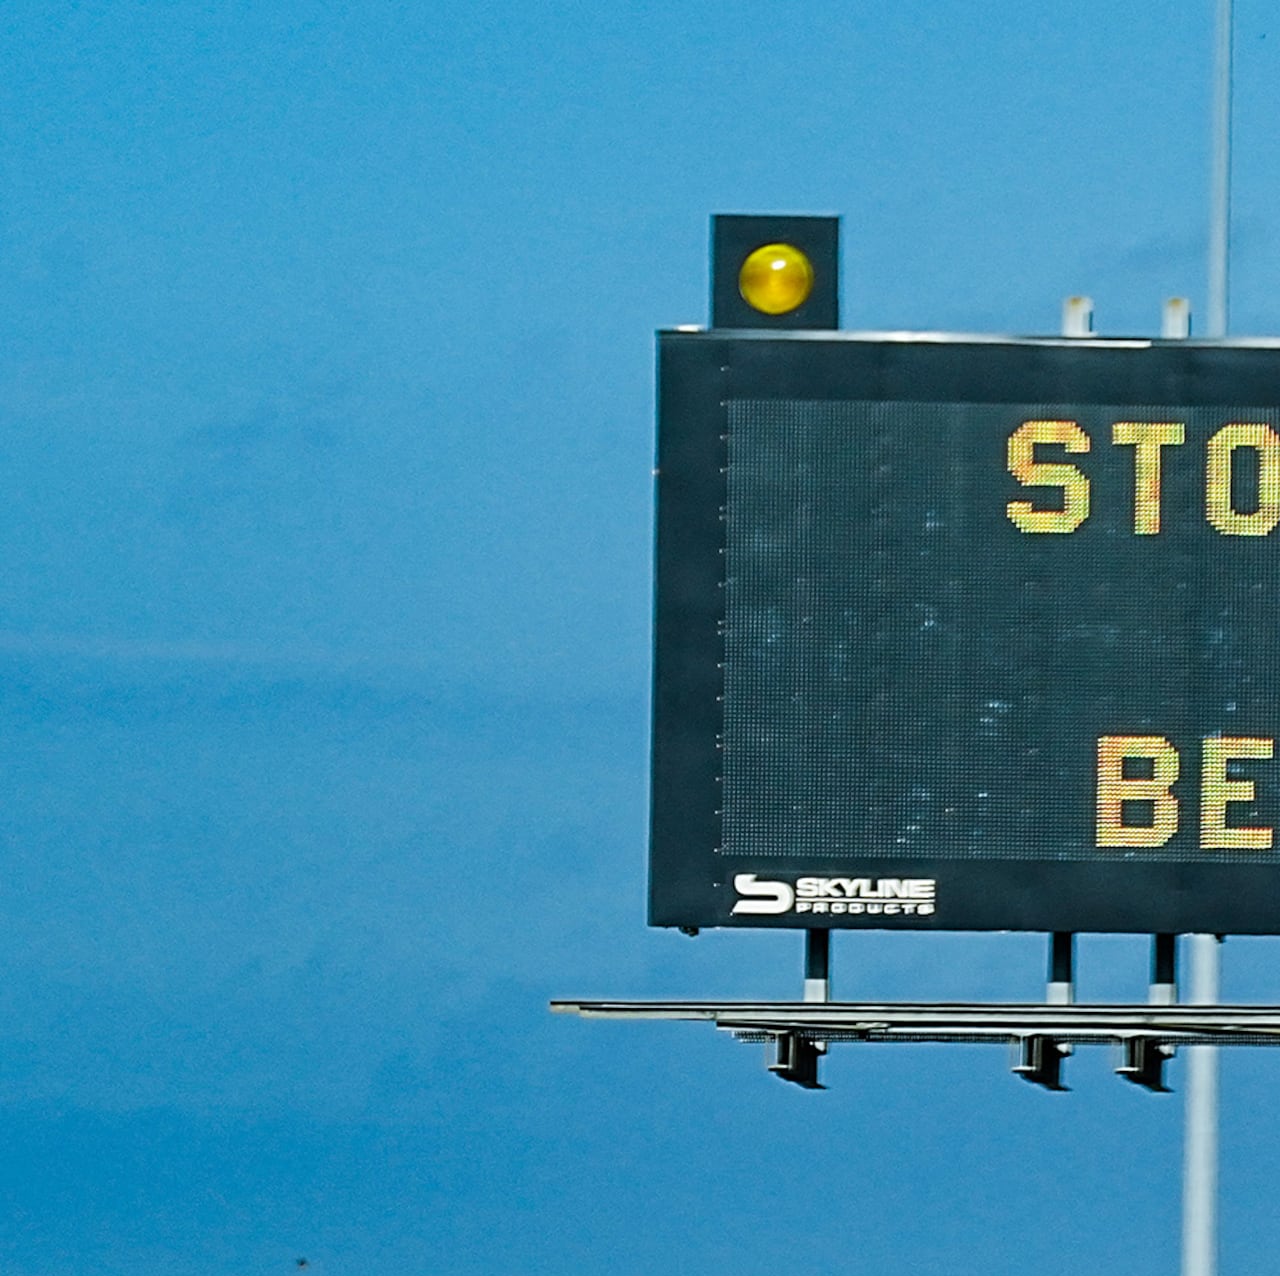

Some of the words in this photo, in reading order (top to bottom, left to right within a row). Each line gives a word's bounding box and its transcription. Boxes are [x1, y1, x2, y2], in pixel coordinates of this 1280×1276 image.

[1096, 735, 1275, 851] BE
[796, 877, 936, 898] SKYLINE
[796, 902, 936, 915] PRODUCTS
